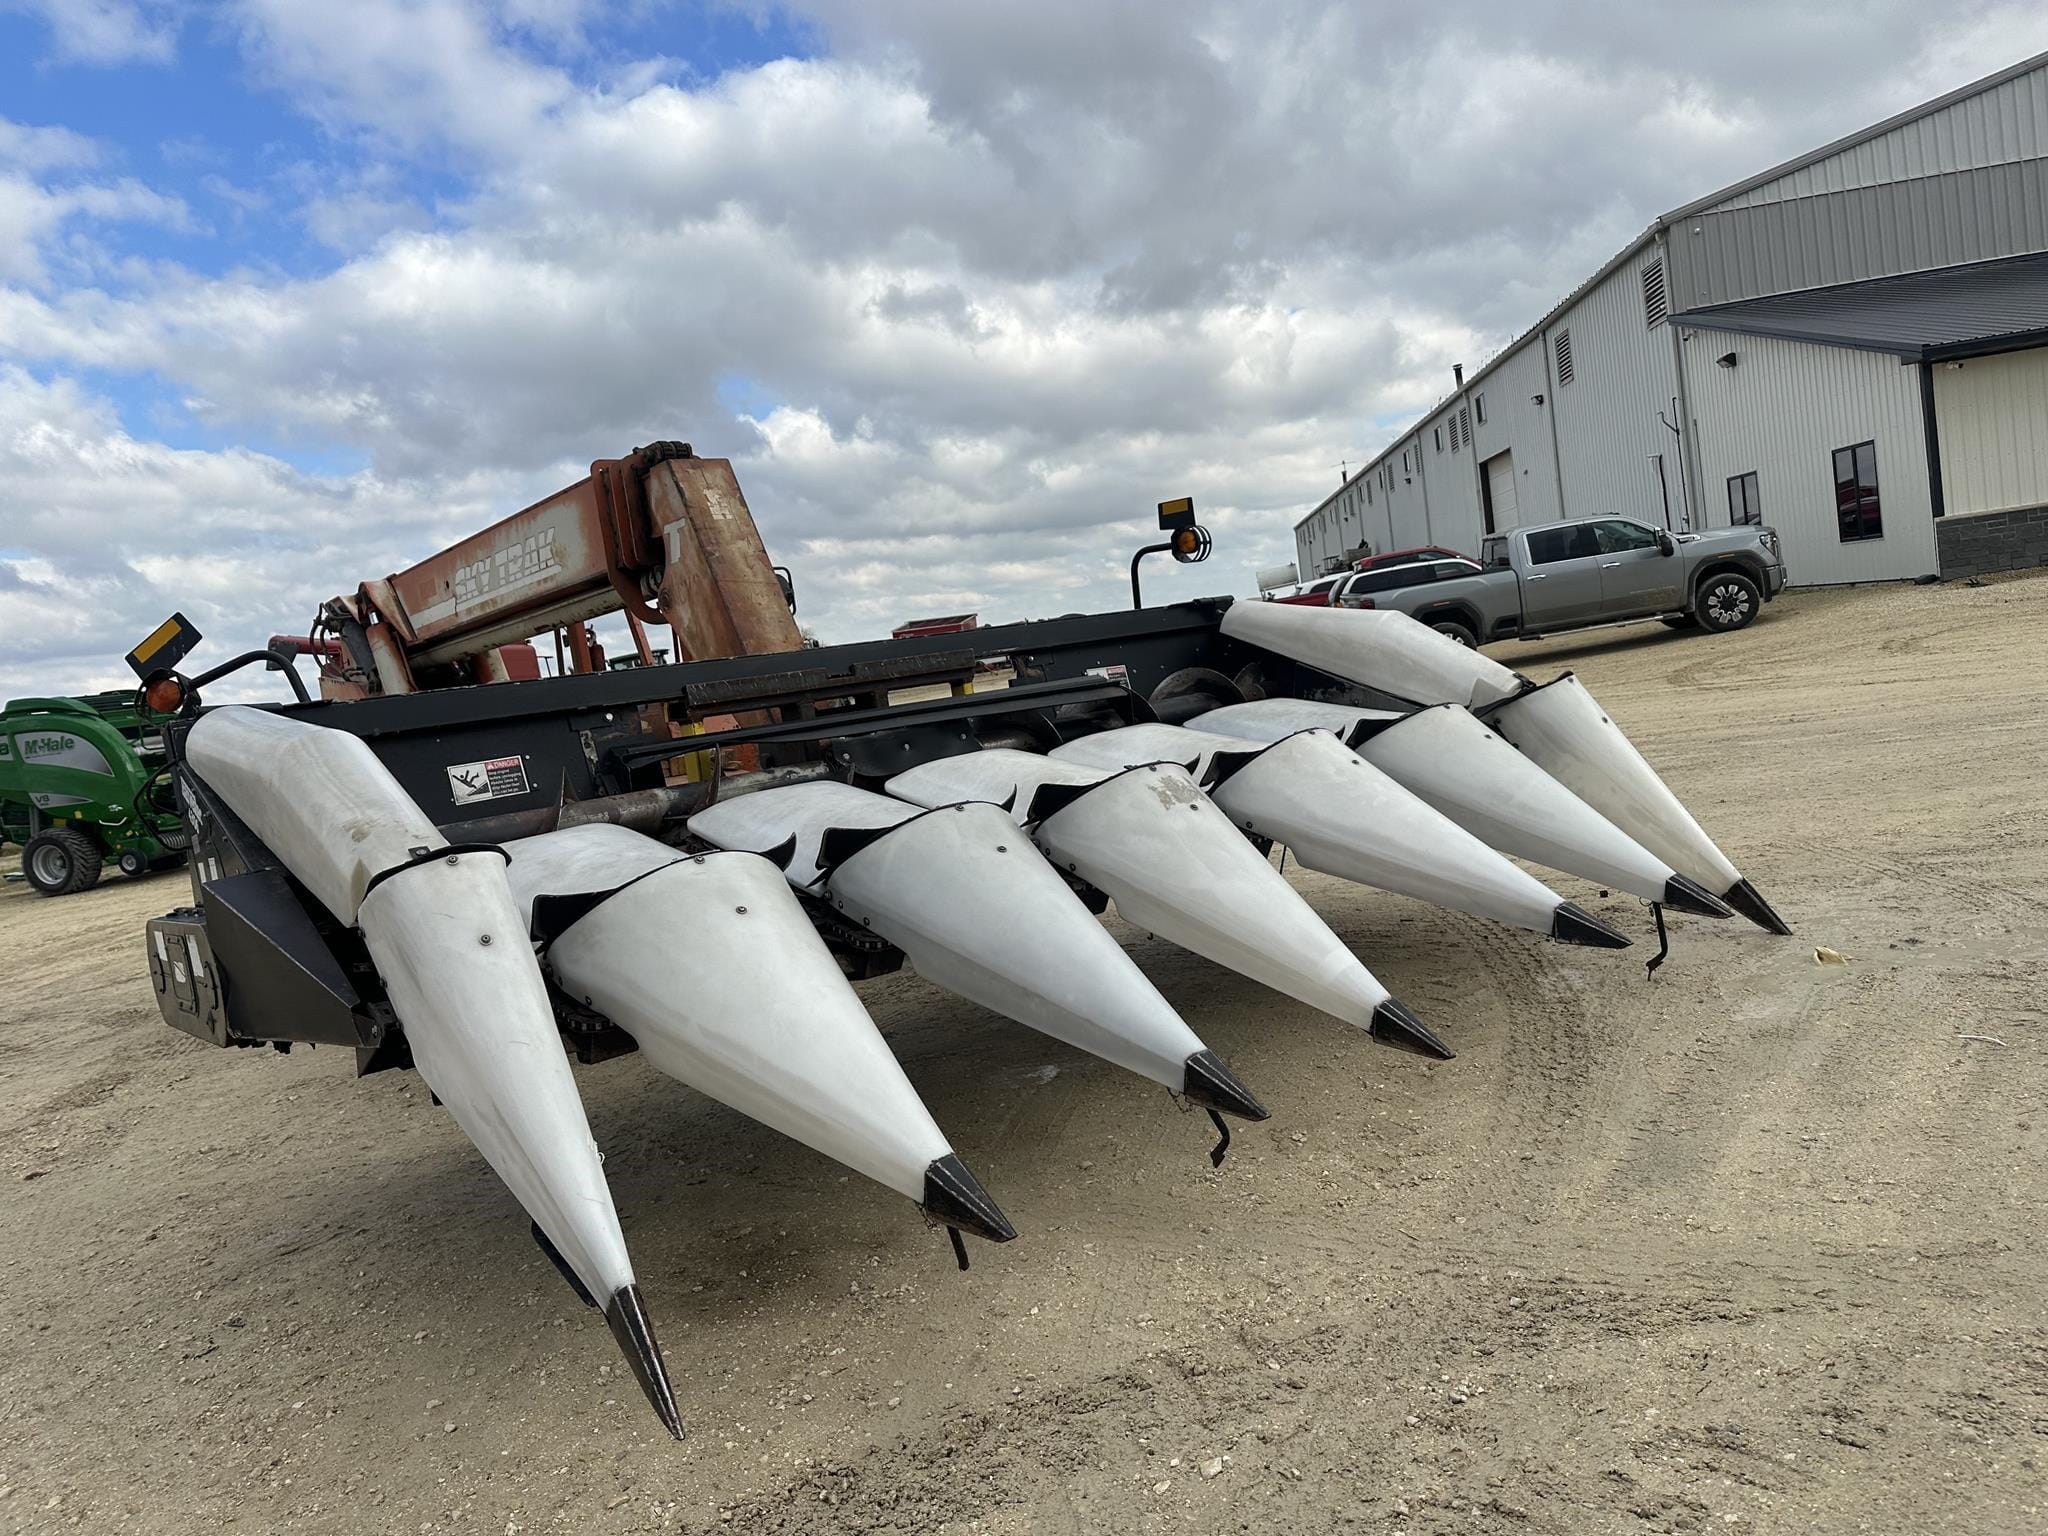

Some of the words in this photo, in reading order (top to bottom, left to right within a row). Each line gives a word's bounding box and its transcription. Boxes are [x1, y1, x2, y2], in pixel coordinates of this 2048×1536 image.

[455, 556, 491, 604] SKY
[494, 526, 556, 587] TRAK
[24, 735, 76, 755] McHale
[493, 757, 520, 769] DANGER
